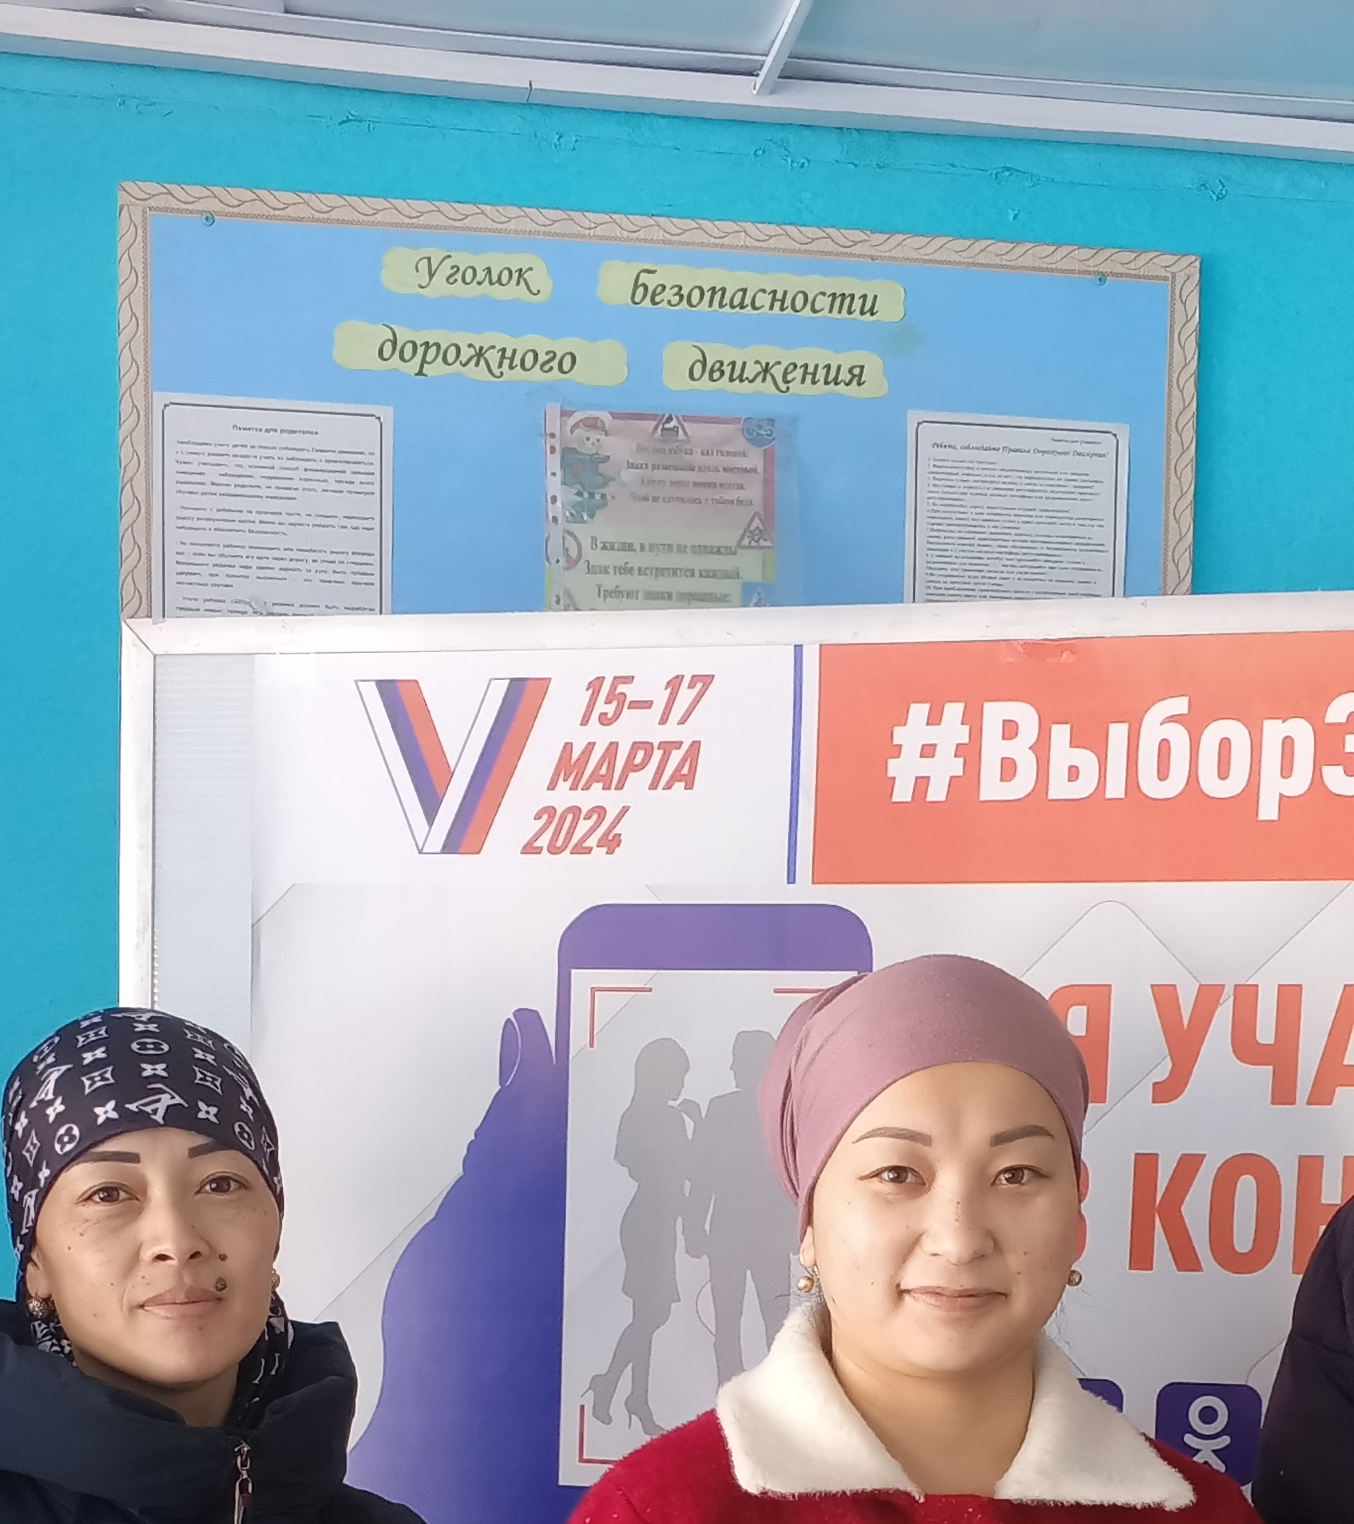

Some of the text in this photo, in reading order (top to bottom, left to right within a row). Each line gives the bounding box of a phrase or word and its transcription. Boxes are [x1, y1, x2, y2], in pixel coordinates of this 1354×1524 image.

[415, 254, 880, 318] Уголок безопасности
[378, 324, 867, 394] дорожного движения
[547, 740, 701, 791] МАРТА
[520, 805, 630, 855] 2024
